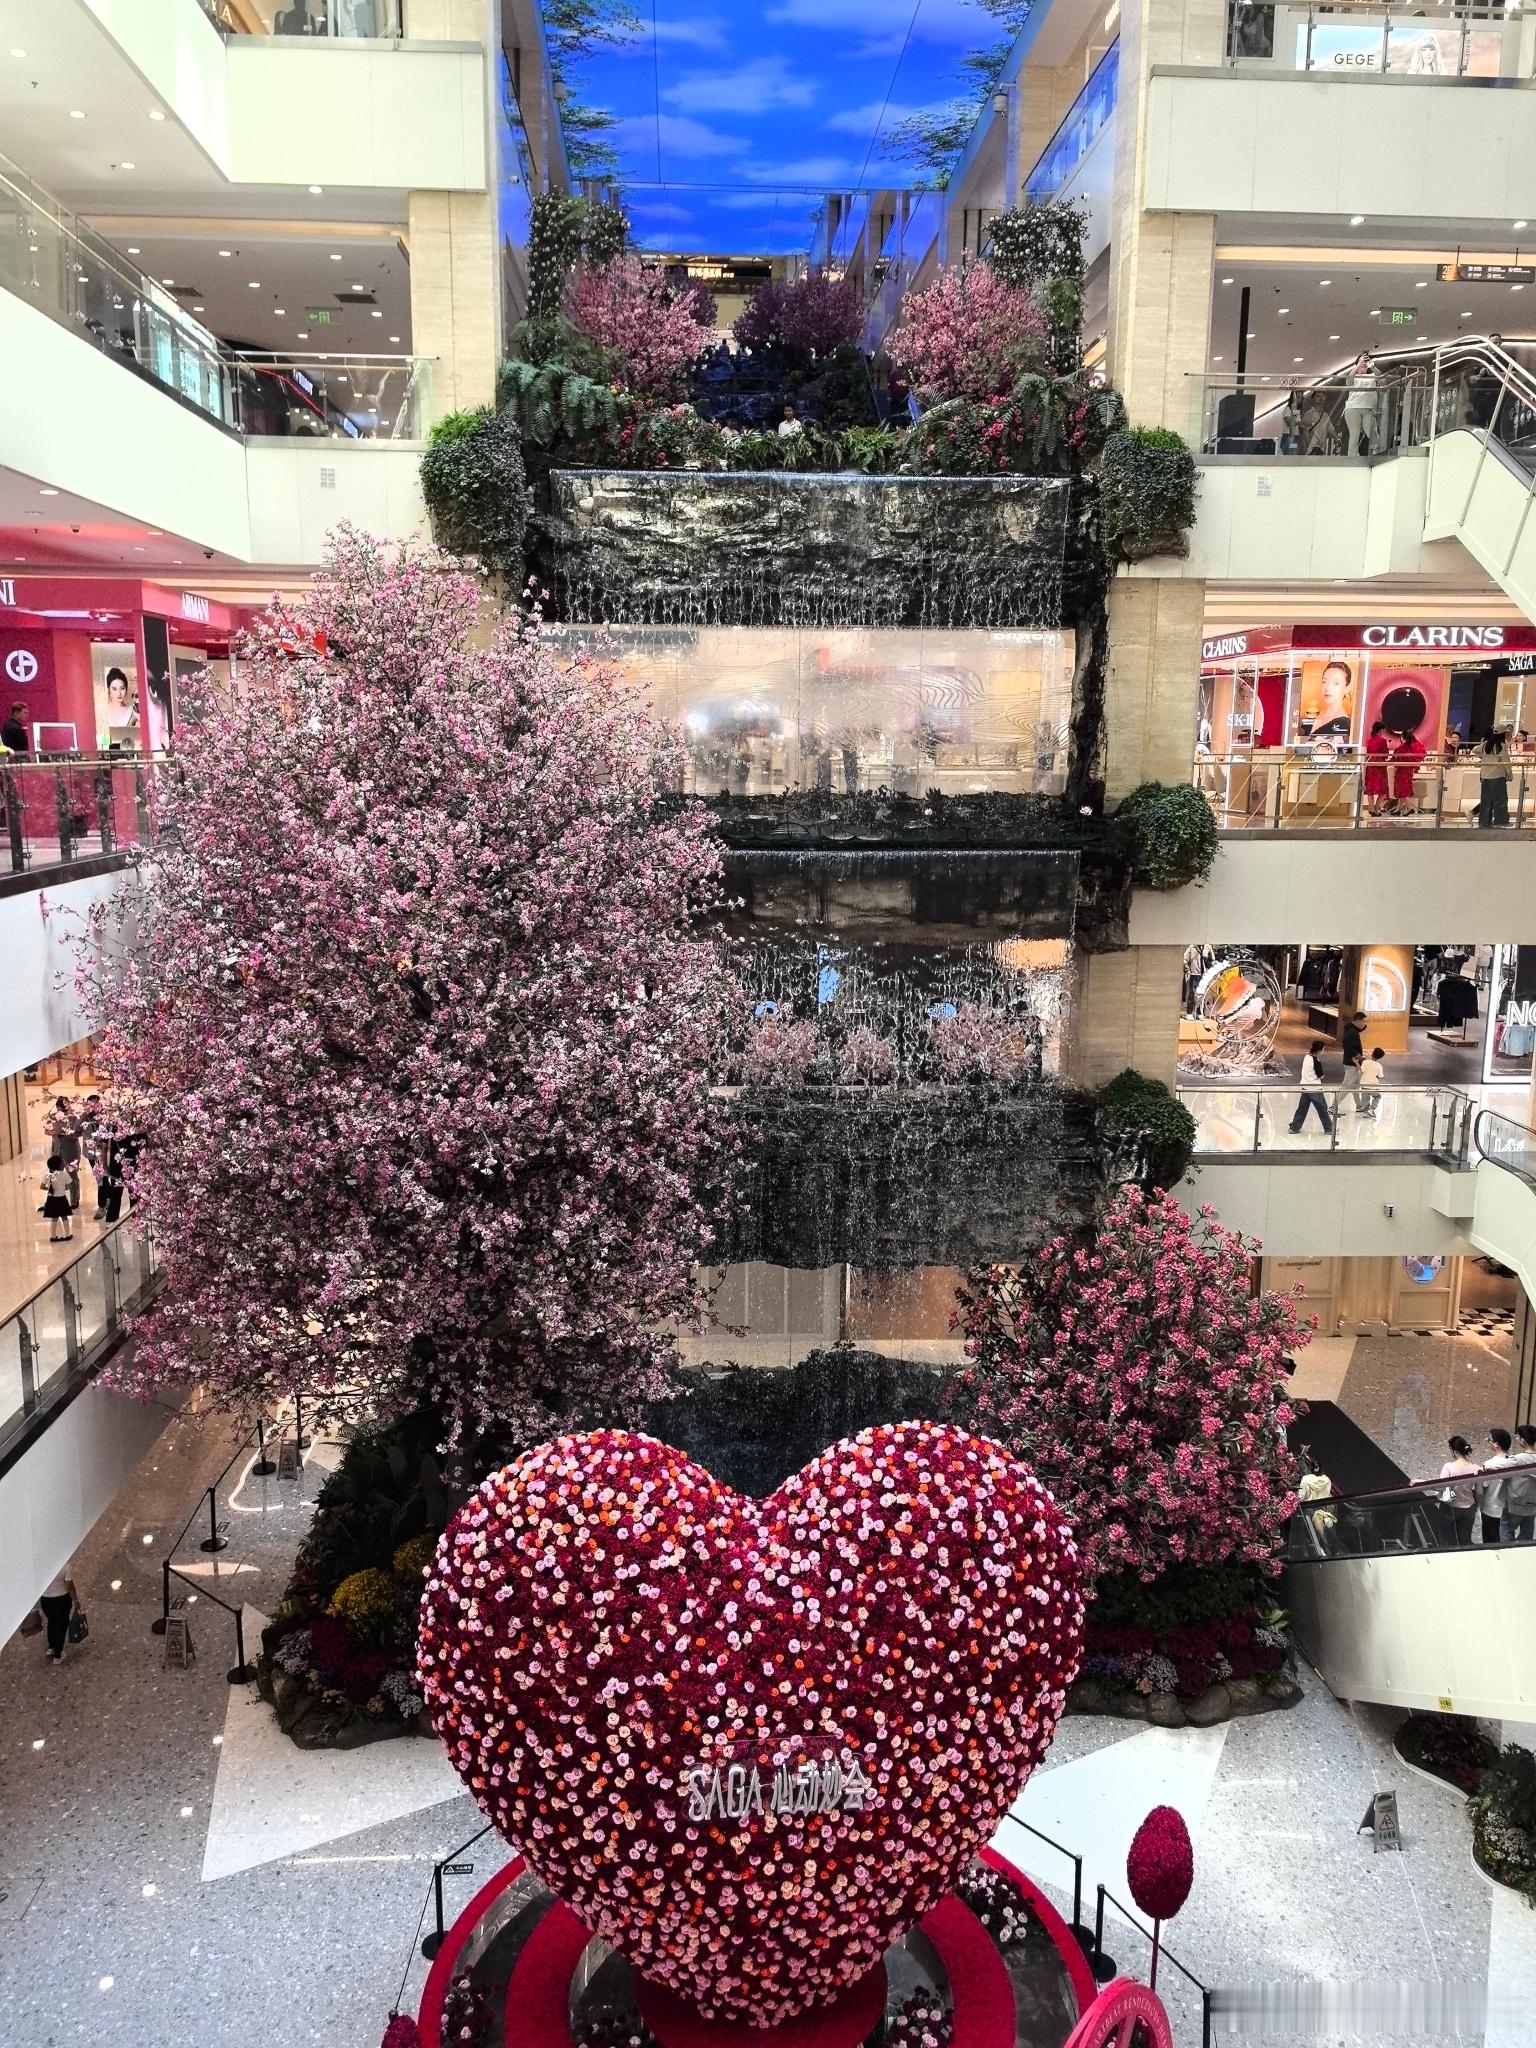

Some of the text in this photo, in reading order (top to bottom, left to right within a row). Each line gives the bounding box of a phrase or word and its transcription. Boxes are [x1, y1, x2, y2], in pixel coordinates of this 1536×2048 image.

[1334, 53, 1375, 66] GEGE
[1203, 635, 1247, 659] CLARINS
[1362, 626, 1504, 647] CLARINS
[1509, 656, 1534, 671] SAGA
[688, 1763, 764, 1821] SAGA
